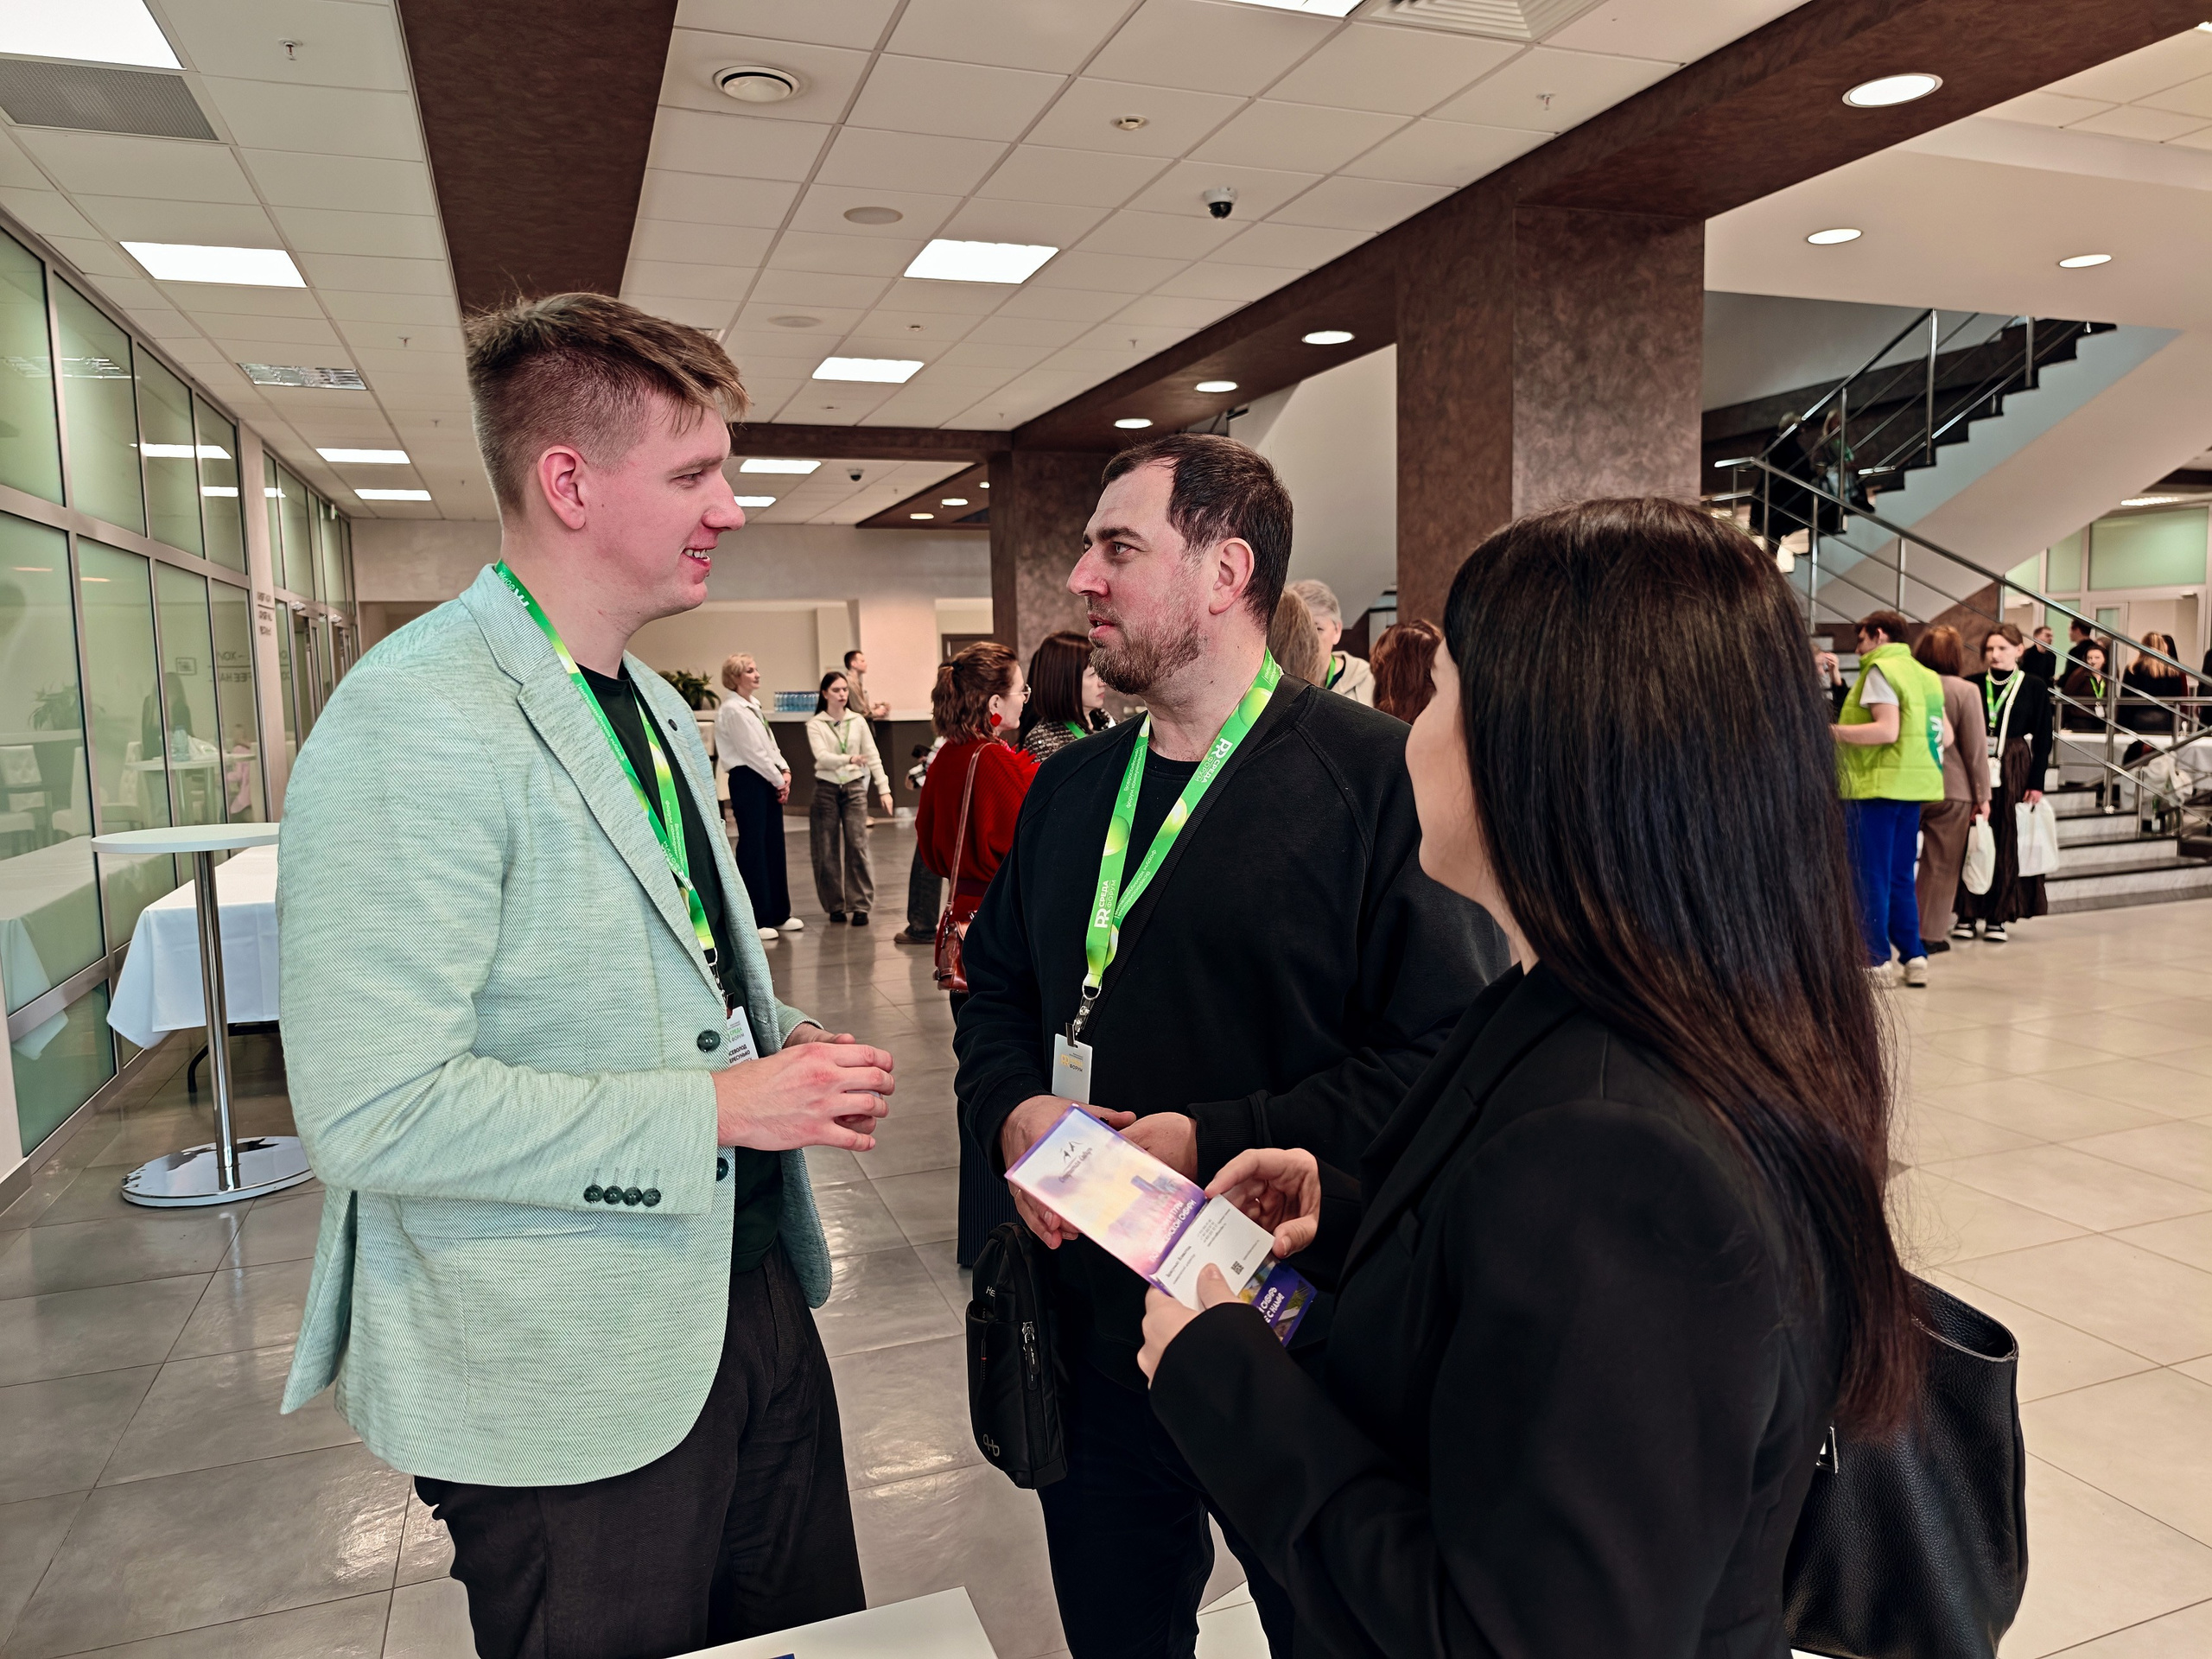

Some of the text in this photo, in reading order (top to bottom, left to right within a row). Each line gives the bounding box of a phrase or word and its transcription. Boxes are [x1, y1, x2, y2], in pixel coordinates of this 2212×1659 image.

[578, 685, 612, 738] коммуникаций
[610, 739, 625, 762] форум
[1211, 738, 1233, 759] PR
[1123, 749, 1139, 791] Всероссийский
[1195, 756, 1213, 782] ФОРУМ
[1201, 760, 1220, 783] СРЕДА
[1143, 849, 1157, 870] форум
[1098, 880, 1109, 907] СРЕДА
[1107, 880, 1116, 908] ФОРУМ
[1117, 871, 1151, 917] Всероссийский
[1094, 907, 1111, 928] PR
[728, 1044, 747, 1056] СЕВОЛОД
